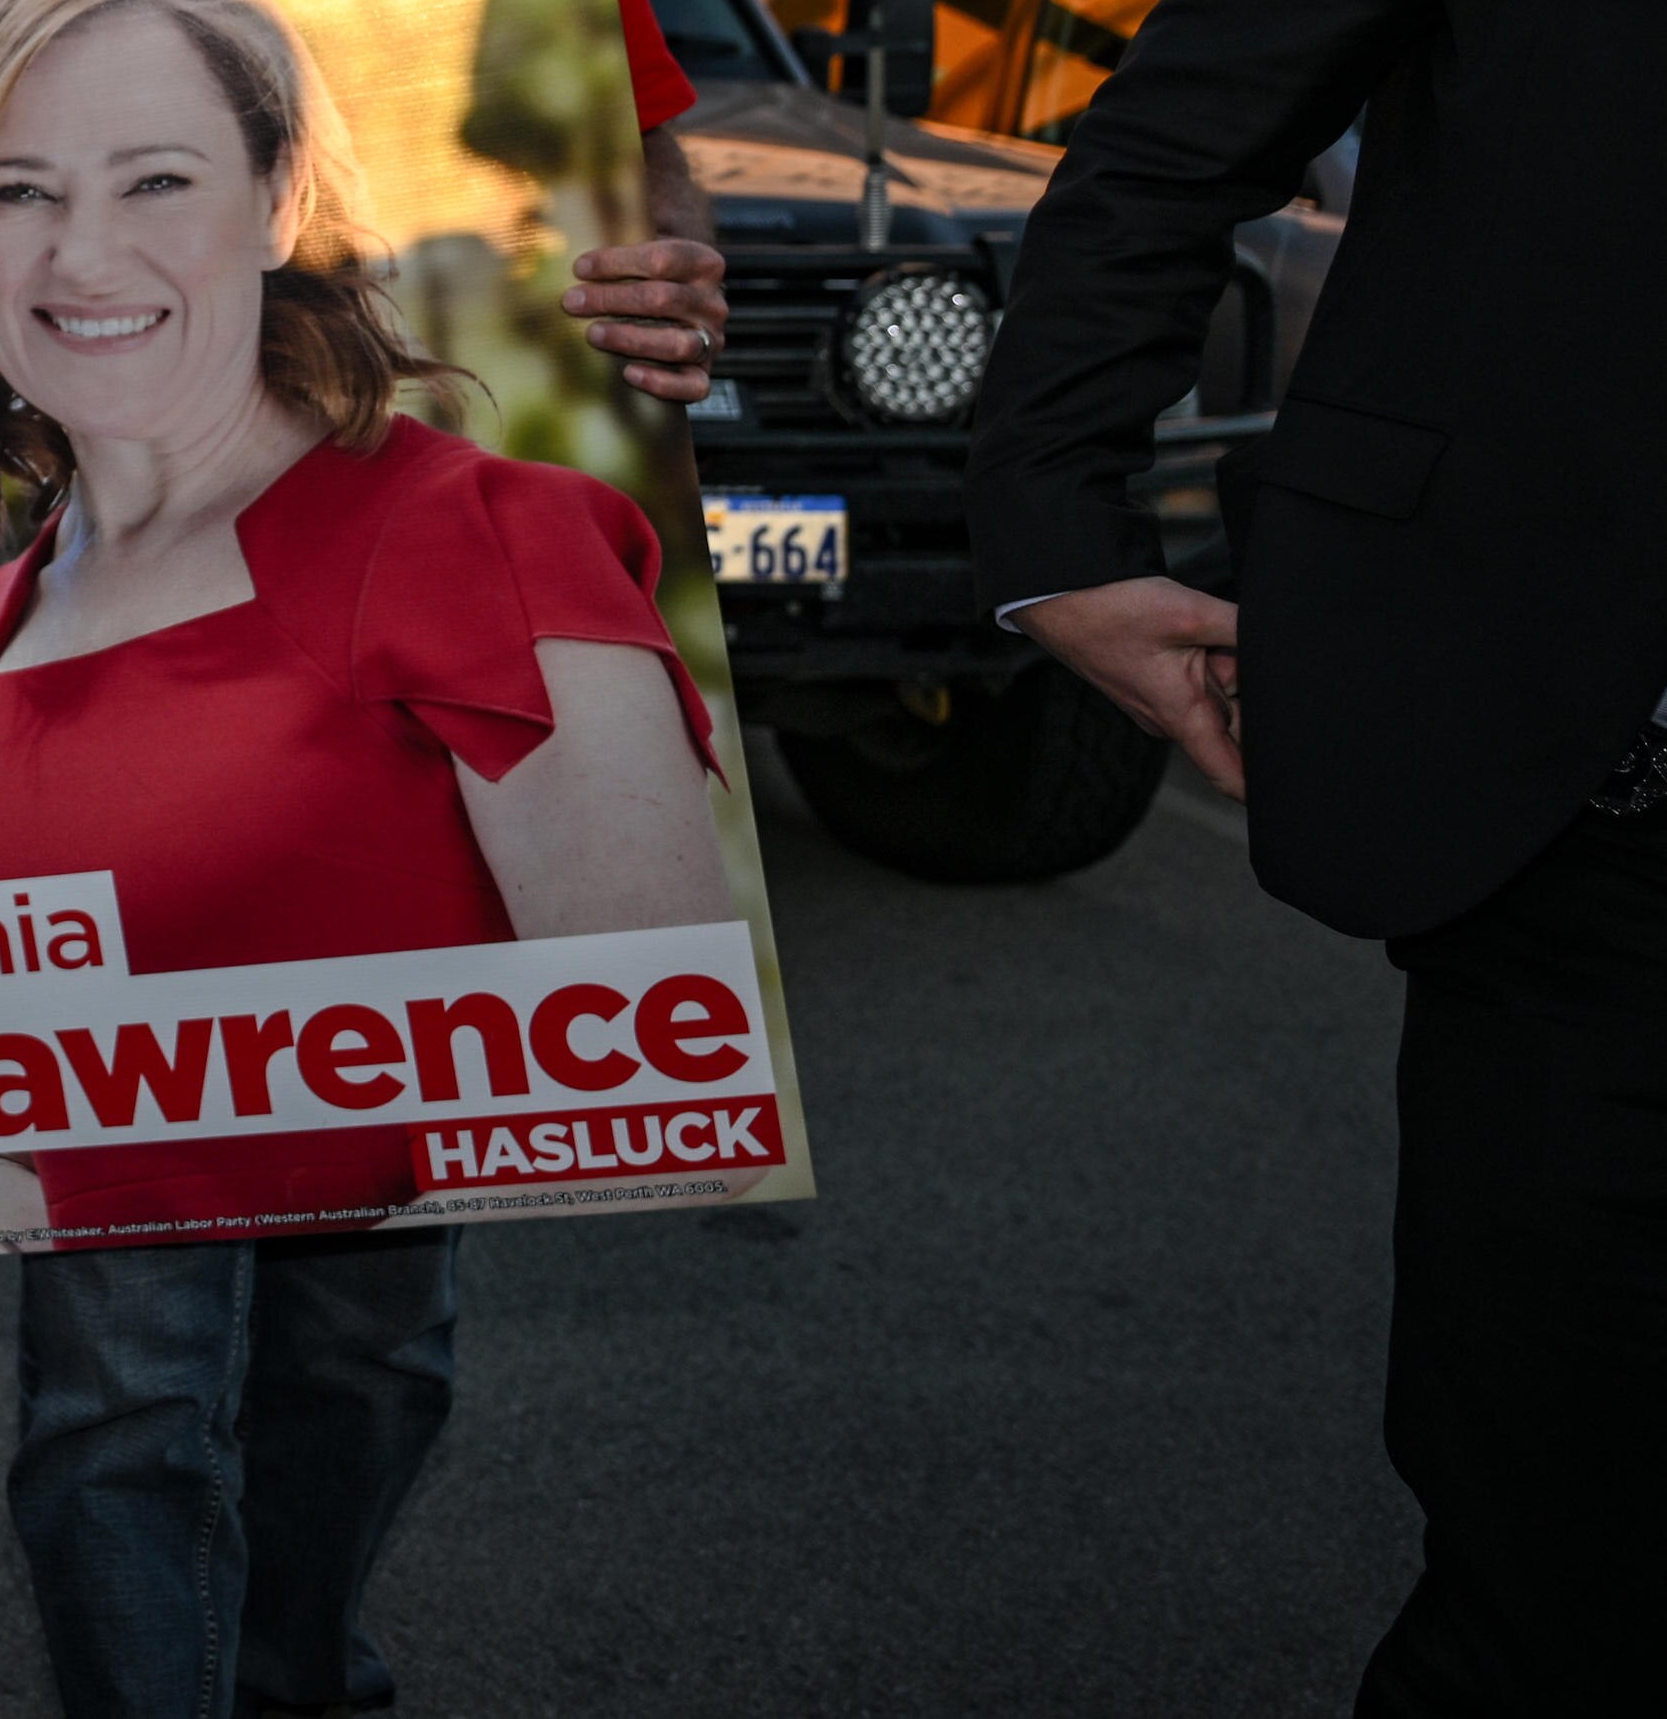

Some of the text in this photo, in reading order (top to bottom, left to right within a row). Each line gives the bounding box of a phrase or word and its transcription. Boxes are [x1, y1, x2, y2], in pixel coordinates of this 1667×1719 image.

[424, 1106, 770, 1182] HASLUCK
[108, 1221, 172, 1236] Australian
[175, 1218, 213, 1231] Labor
[216, 1215, 252, 1229] Party
[254, 1210, 316, 1227] (Western
[318, 1207, 386, 1221] Australian
[576, 1189, 615, 1204] West
[616, 1185, 654, 1201] Perth
[655, 1184, 682, 1197] WA
